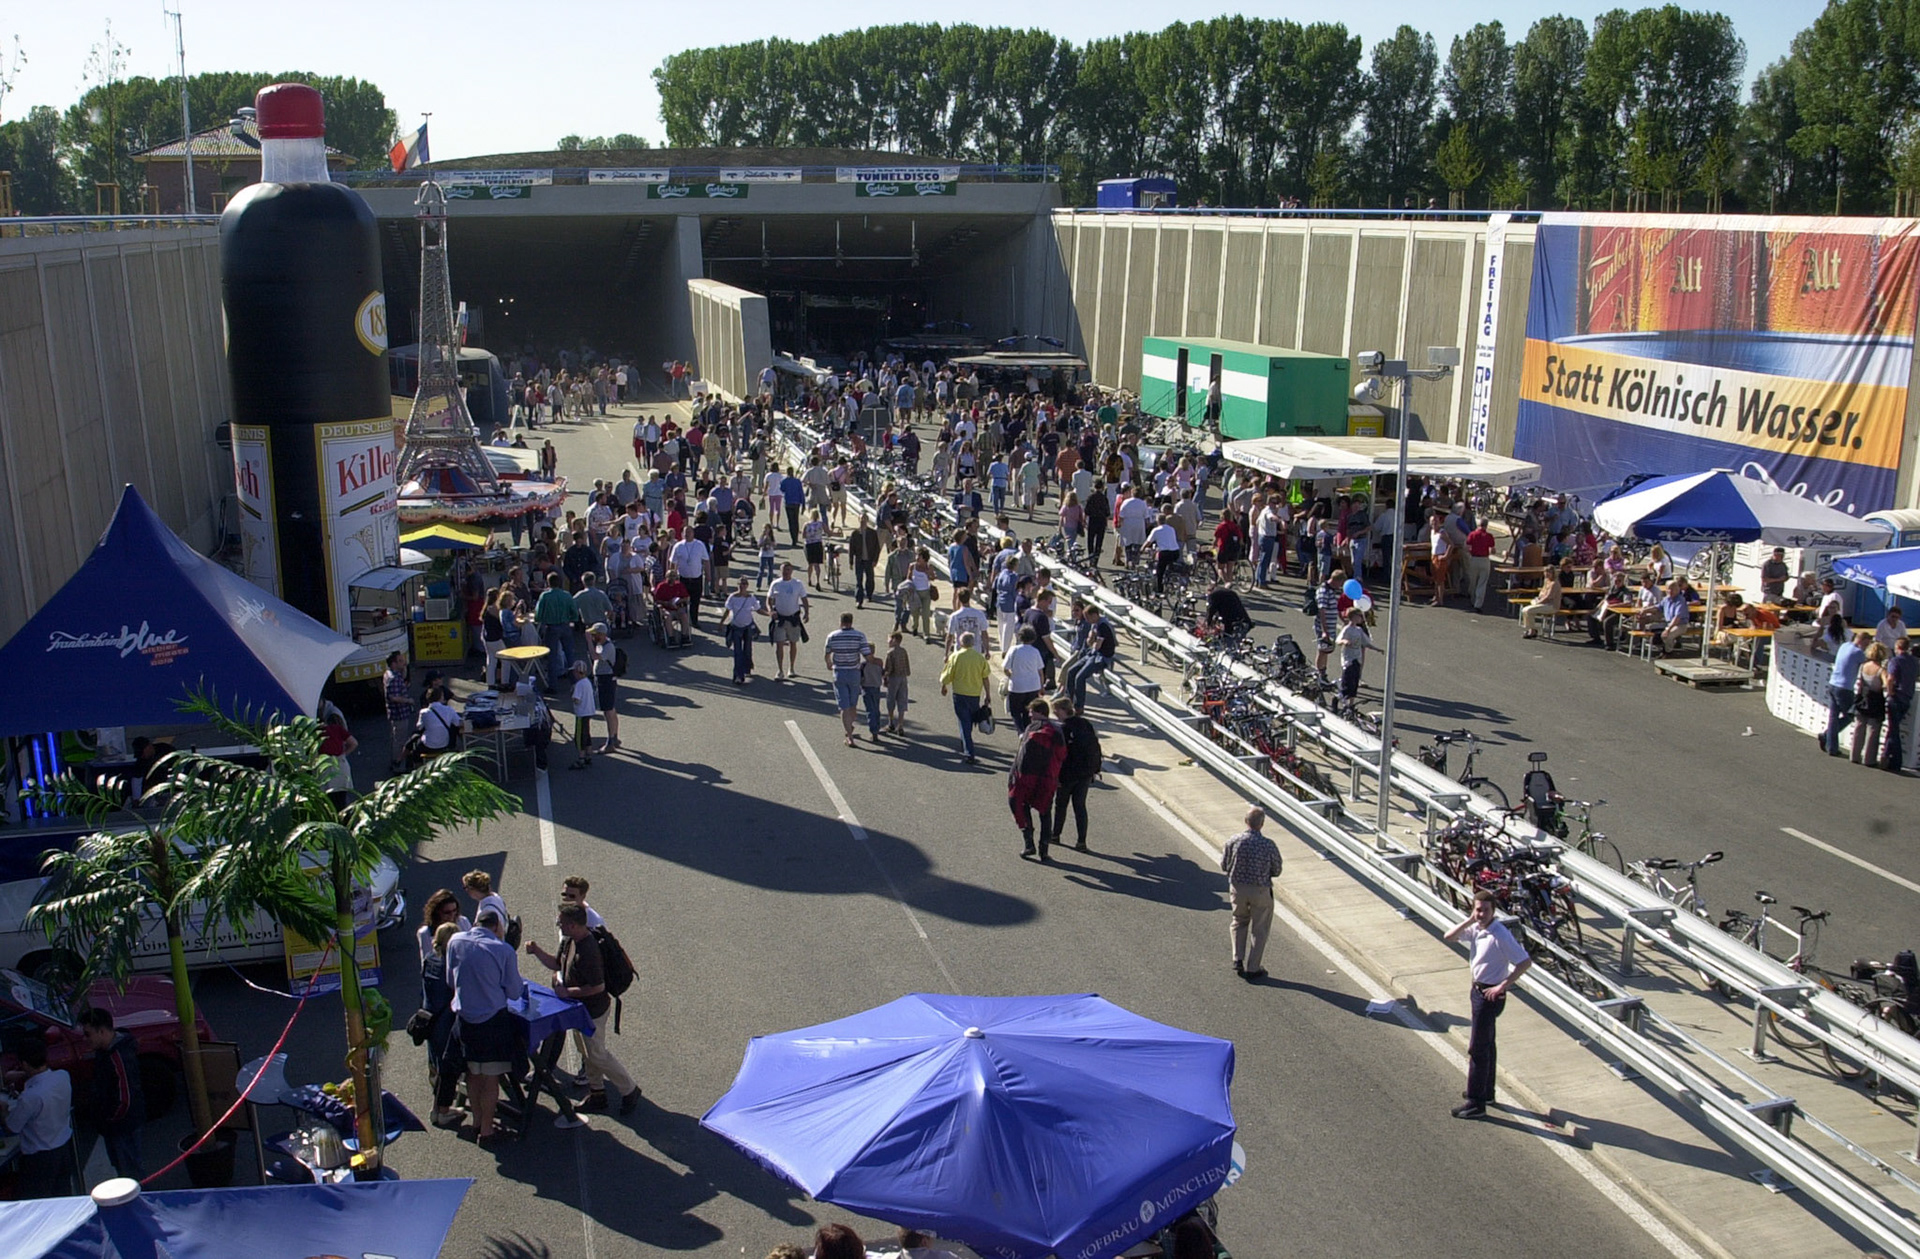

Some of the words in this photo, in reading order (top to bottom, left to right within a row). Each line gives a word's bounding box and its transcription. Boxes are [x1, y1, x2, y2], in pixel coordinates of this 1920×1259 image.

[657, 183, 690, 198] Carlsberg
[705, 183, 738, 198] Carlsberg
[856, 172, 940, 181] TUNNELDISCO
[865, 183, 900, 196] Carlsberg
[1669, 255, 1703, 293] Alt
[1801, 247, 1841, 299] Alt
[1483, 254, 1498, 336] FREITAG
[1477, 367, 1492, 452] DISCO
[1541, 355, 1604, 406] Statt
[1607, 367, 1733, 429] Kölnisch
[1736, 386, 1863, 450] Wasser.
[46, 630, 121, 652] Frankenheim
[117, 620, 189, 659] blue
[1077, 1219, 1140, 1259] HOFBRÄU
[1156, 1163, 1229, 1213] MÜNCHEN
